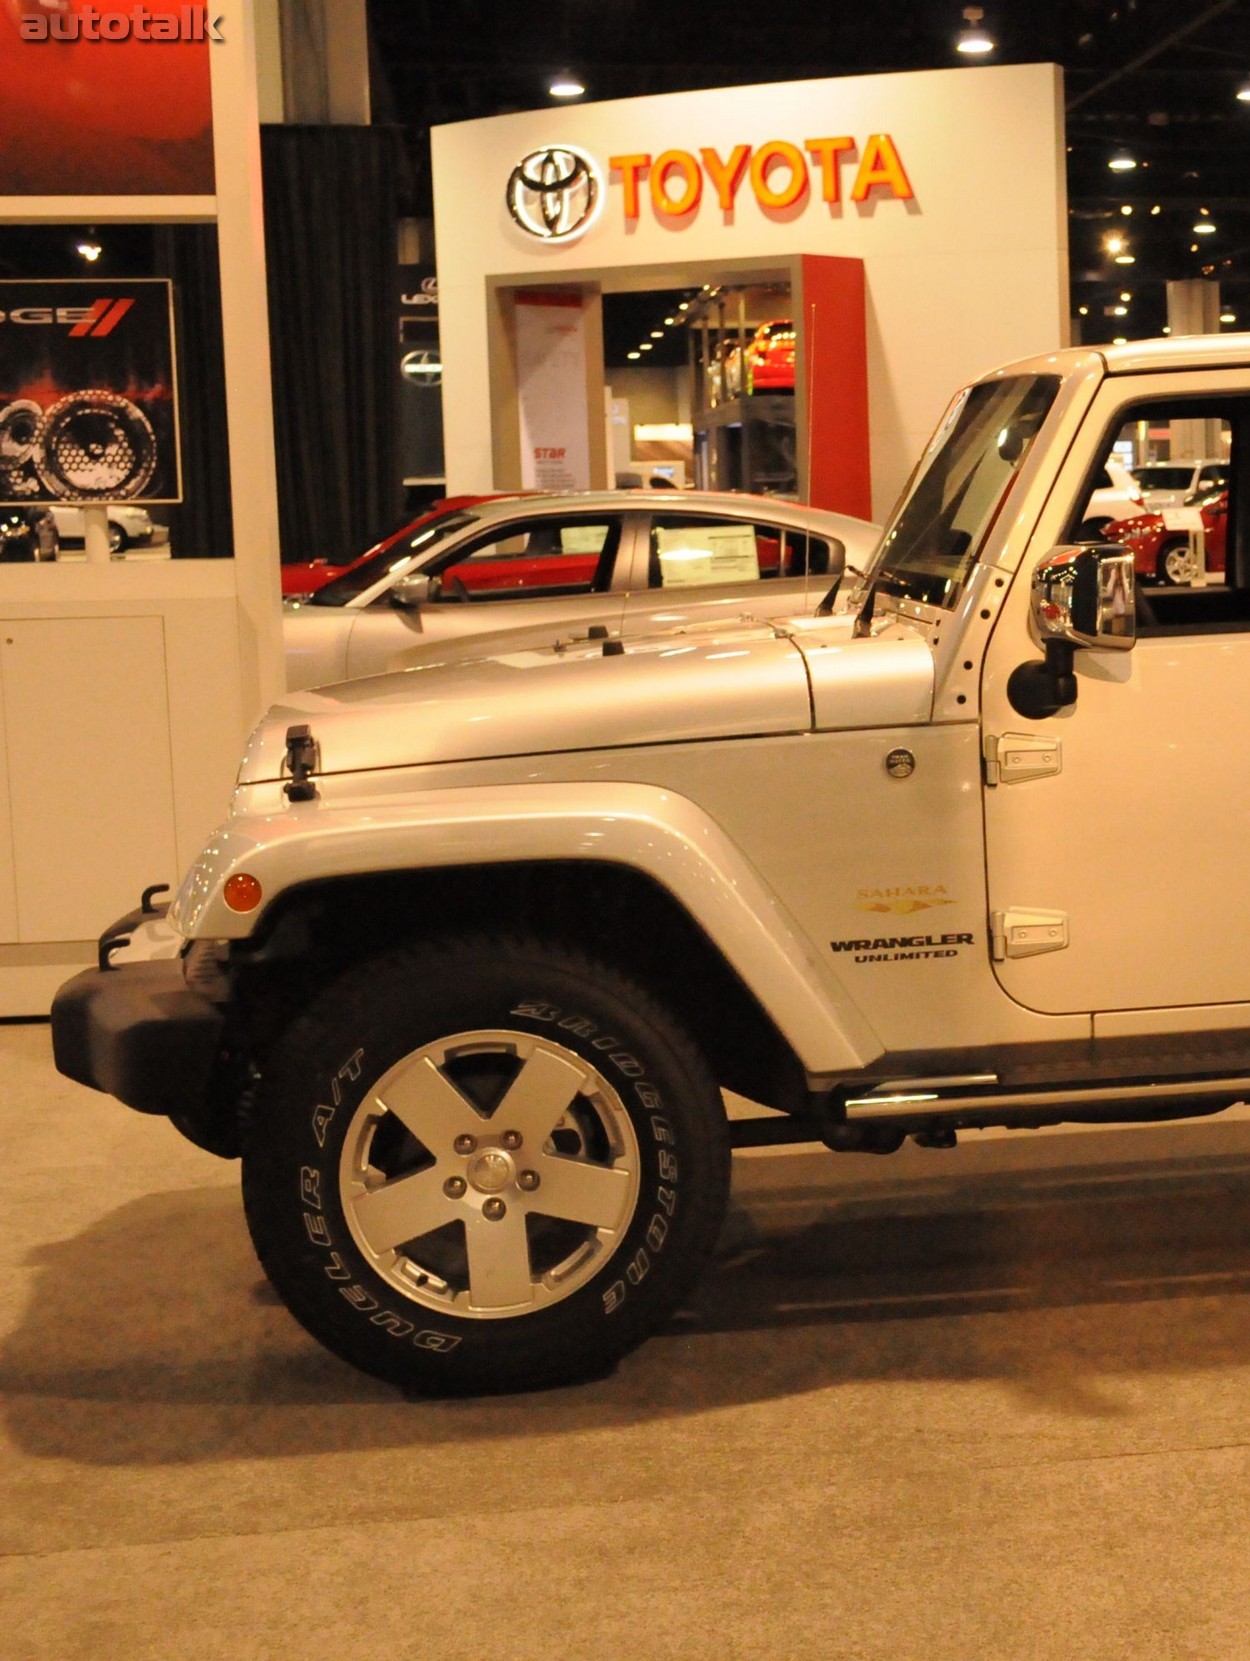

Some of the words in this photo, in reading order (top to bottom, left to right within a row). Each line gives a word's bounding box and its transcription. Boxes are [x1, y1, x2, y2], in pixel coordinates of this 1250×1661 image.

[608, 134, 913, 220] TOYOTA
[857, 884, 948, 899] SAHARA
[830, 932, 975, 952] WRANGLER
[854, 949, 959, 963] UNLIMITED
[312, 1047, 365, 1148] A/T
[508, 1000, 679, 1315] BRIDGESTONE
[300, 1165, 463, 1353] DUELER
